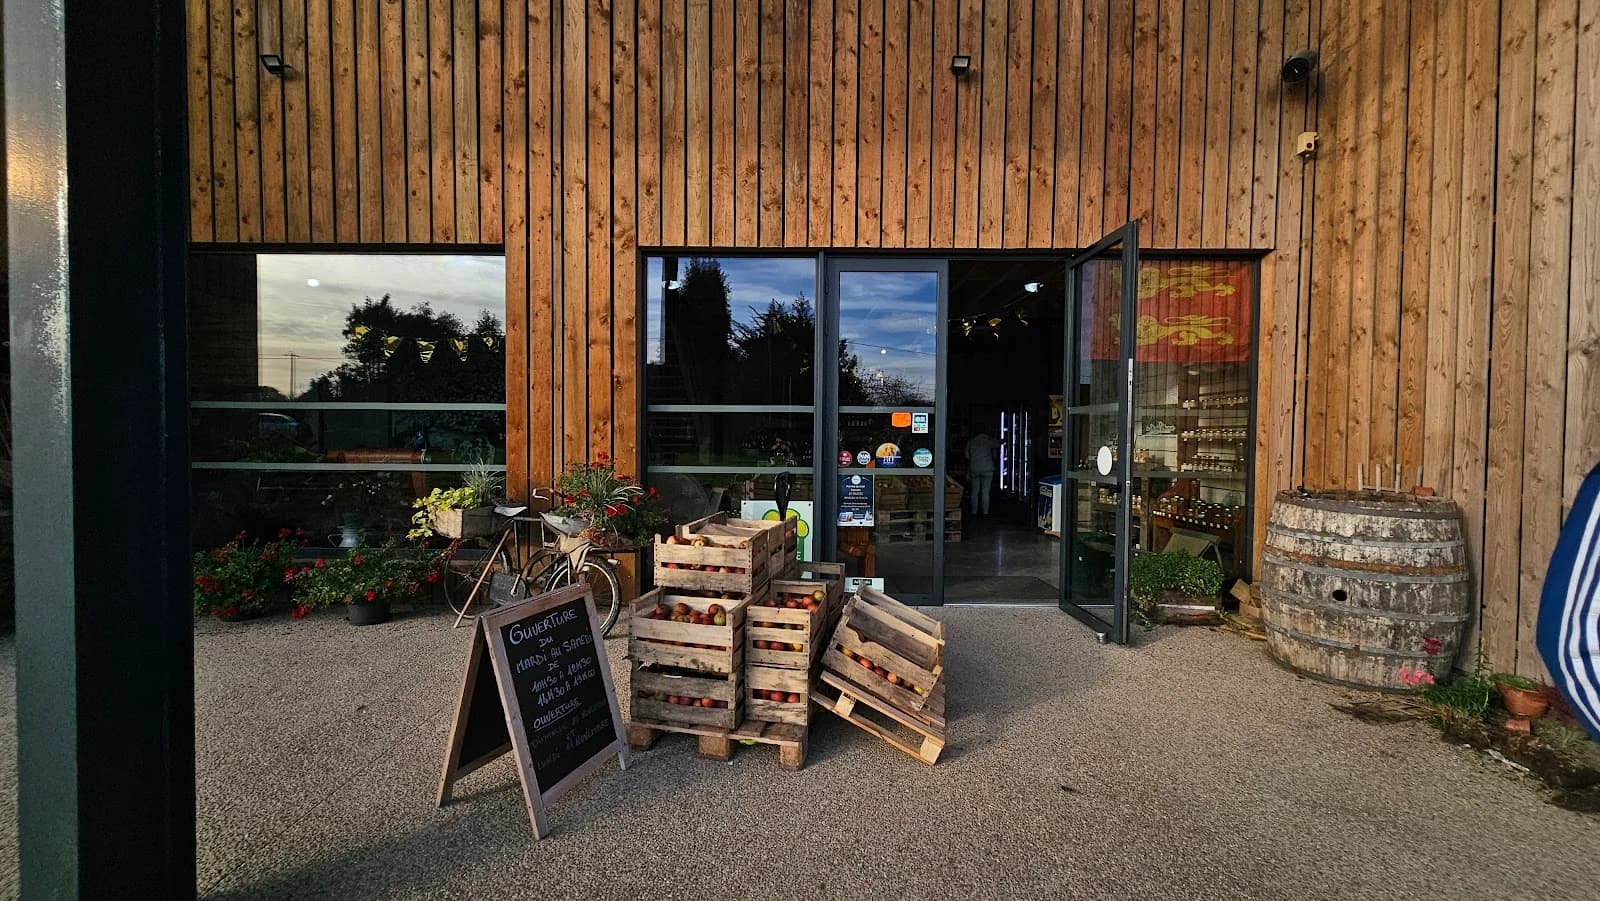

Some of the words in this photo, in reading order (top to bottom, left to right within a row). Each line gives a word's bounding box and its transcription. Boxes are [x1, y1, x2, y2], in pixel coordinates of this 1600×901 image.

[538, 635, 554, 648] DU
[550, 647, 562, 659] AU
[547, 660, 560, 672] DE
[533, 696, 582, 729] OUVERTURE
